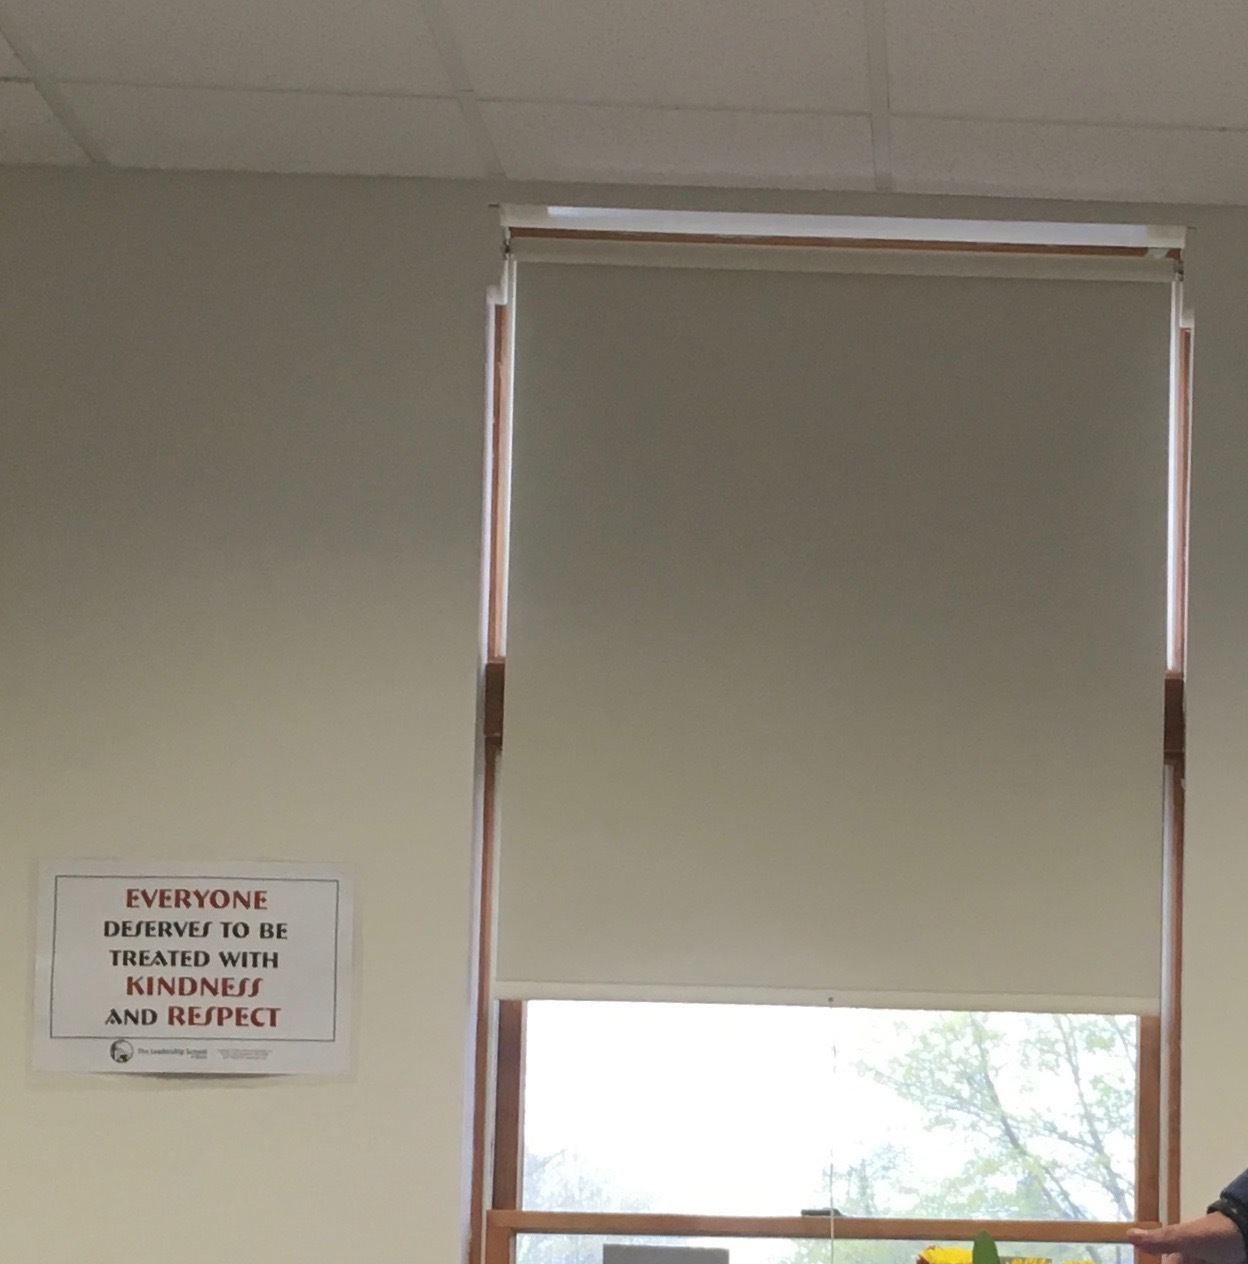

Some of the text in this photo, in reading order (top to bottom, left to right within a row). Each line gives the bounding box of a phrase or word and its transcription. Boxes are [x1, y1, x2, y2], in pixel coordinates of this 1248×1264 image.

[126, 888, 268, 910] EVERYONE
[103, 920, 288, 940] DESERVES TO BE
[109, 949, 279, 969] TREATED WITH
[126, 975, 263, 998] KINDNESS
[104, 1005, 282, 1028] AND RESPECT
